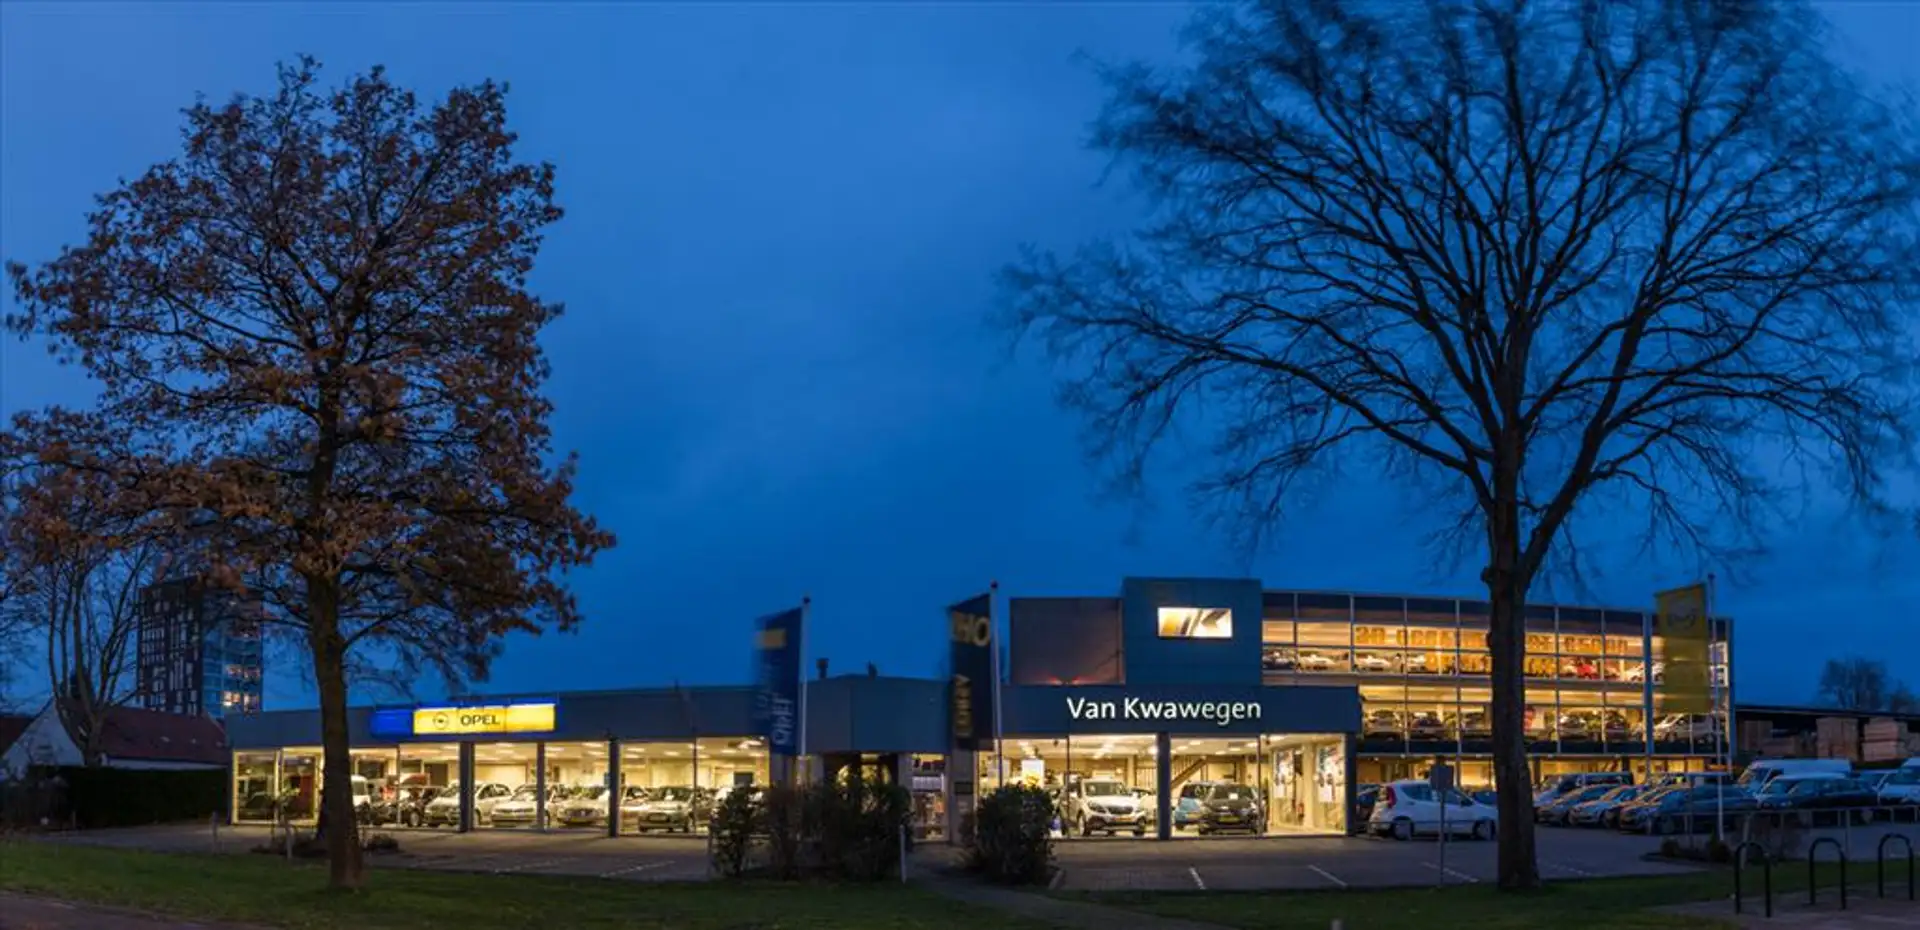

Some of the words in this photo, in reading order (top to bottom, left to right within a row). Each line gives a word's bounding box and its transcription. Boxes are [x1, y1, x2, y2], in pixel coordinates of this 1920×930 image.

[461, 714, 500, 726] OPEL
[1066, 697, 1115, 719] Van
[1124, 697, 1261, 725] Kwawegen
